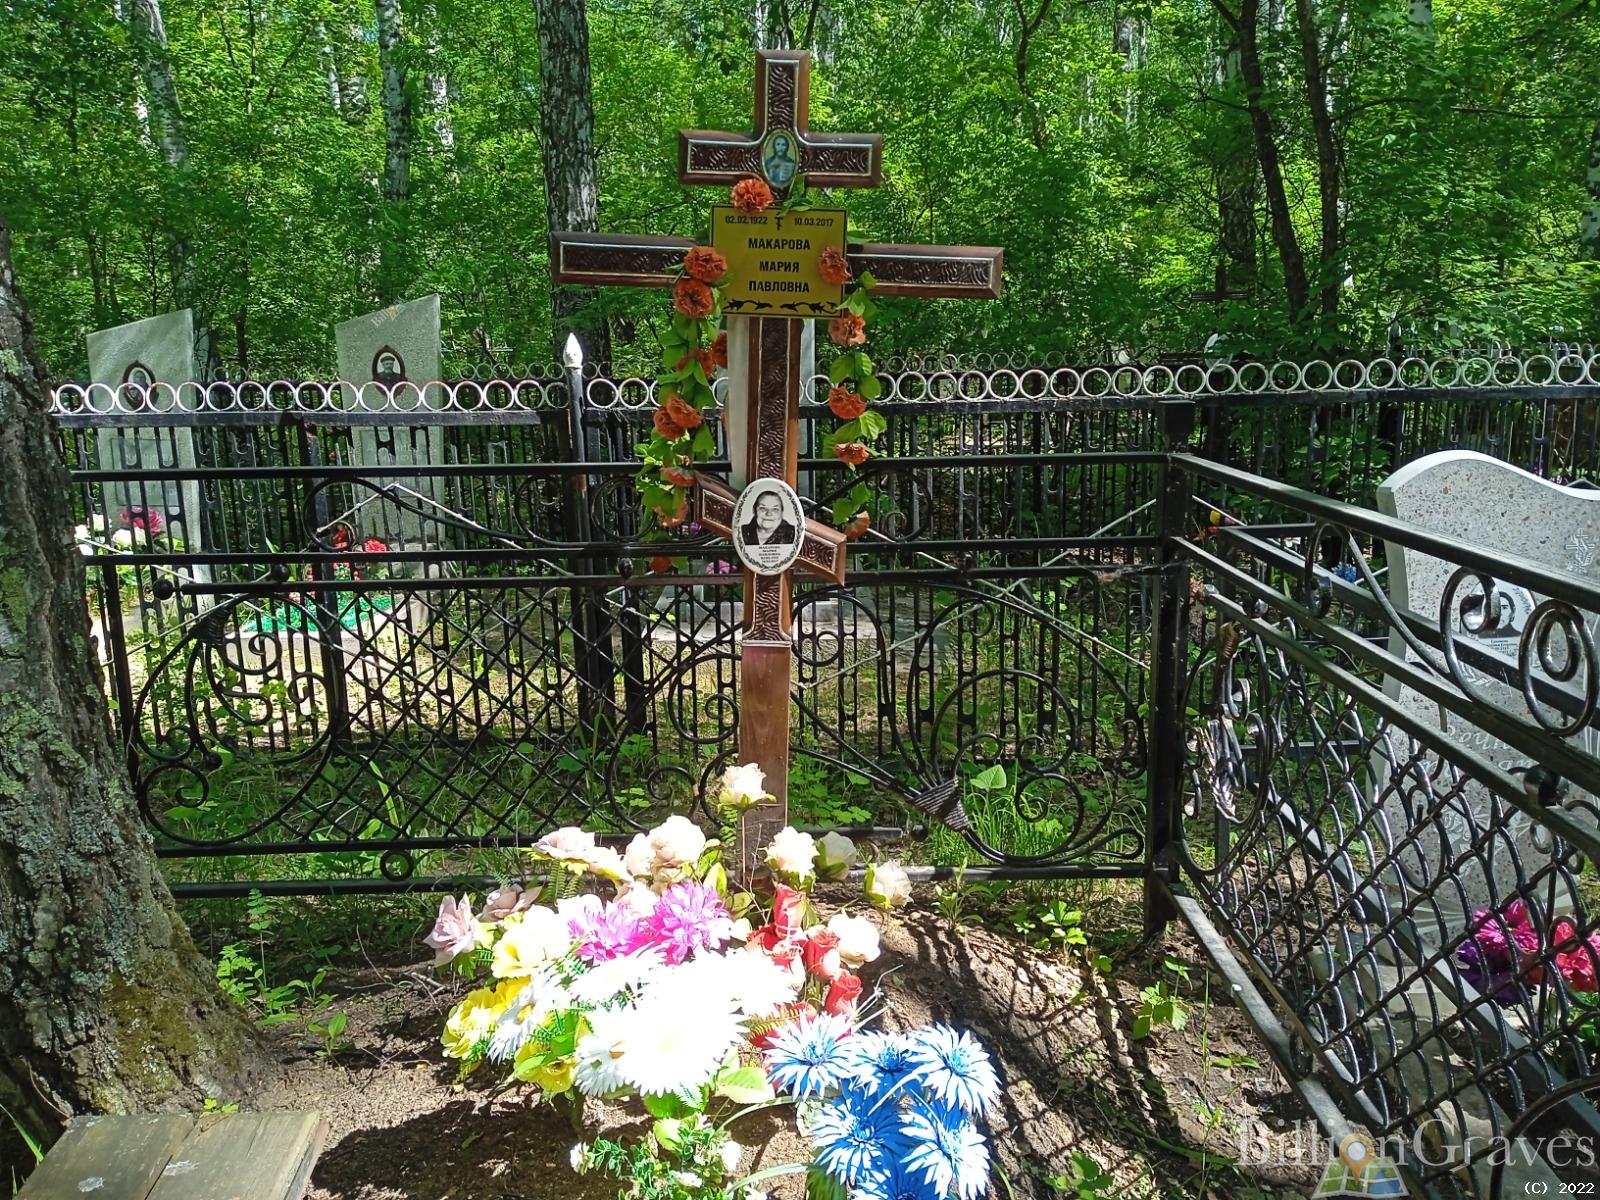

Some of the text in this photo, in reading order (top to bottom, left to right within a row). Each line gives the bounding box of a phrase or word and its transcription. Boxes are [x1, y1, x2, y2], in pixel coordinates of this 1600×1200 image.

[725, 215, 834, 227] 02.02.1922 10.03.2017
[748, 238, 811, 250] МАКАРОВА
[760, 261, 799, 273] МАРИЯ
[749, 281, 810, 293] ПАВЛОВНА
